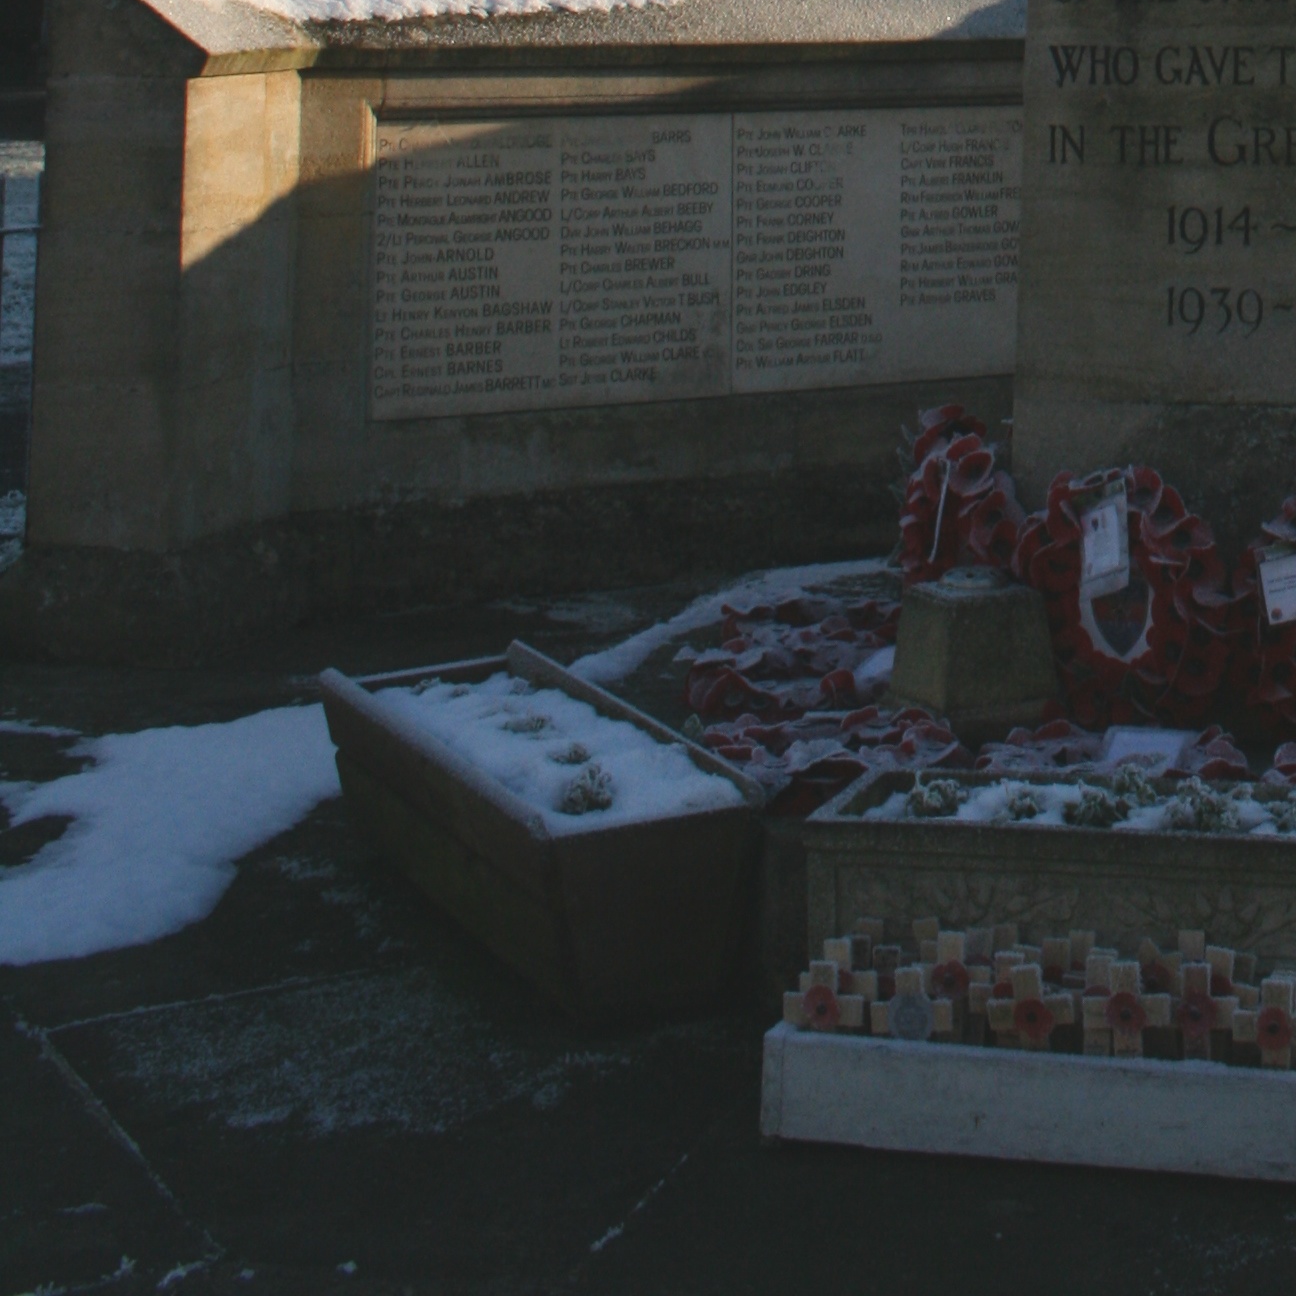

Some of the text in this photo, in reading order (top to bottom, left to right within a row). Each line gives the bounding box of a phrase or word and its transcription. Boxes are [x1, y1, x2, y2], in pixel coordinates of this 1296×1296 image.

[1049, 45, 1140, 88] WHO
[1155, 45, 1257, 87] GAVE
[652, 130, 691, 143] BARRS
[1048, 124, 1086, 165] IN
[1110, 124, 1185, 165] THE
[949, 154, 993, 167] FRANCIS
[484, 171, 551, 185] AMBROSE
[615, 167, 645, 180] BAYS
[952, 172, 1002, 184] FRANKLIN
[663, 182, 718, 196] BEDFORD
[494, 189, 549, 204] ANDREW
[794, 195, 841, 208] COOPER
[498, 208, 551, 222] ANGOOD
[677, 202, 713, 215] BEEBY
[952, 205, 998, 218] GOWLER
[787, 212, 833, 226] CORNEY
[495, 226, 549, 241] ANGOOD
[653, 220, 702, 234] BEHAGG
[787, 229, 845, 243] DEIGHTON
[436, 247, 494, 262] ARNOLD
[786, 246, 843, 261] DEIGHTON
[625, 257, 674, 271] BREWER
[448, 266, 497, 280] AUSTIN
[682, 273, 708, 286] BULL
[450, 284, 499, 299] AUSTIN
[783, 282, 826, 296] EDGLEY
[953, 289, 995, 302] GRAVES
[482, 299, 552, 316] BAGSHAW
[822, 296, 865, 310] ELSDEN
[621, 311, 680, 326] CHAPMAN
[497, 318, 551, 334] BARBER
[814, 332, 857, 346] FARRAR
[446, 340, 501, 356] BARBER
[447, 358, 502, 375] BARNES
[485, 375, 540, 391] BARRETT
